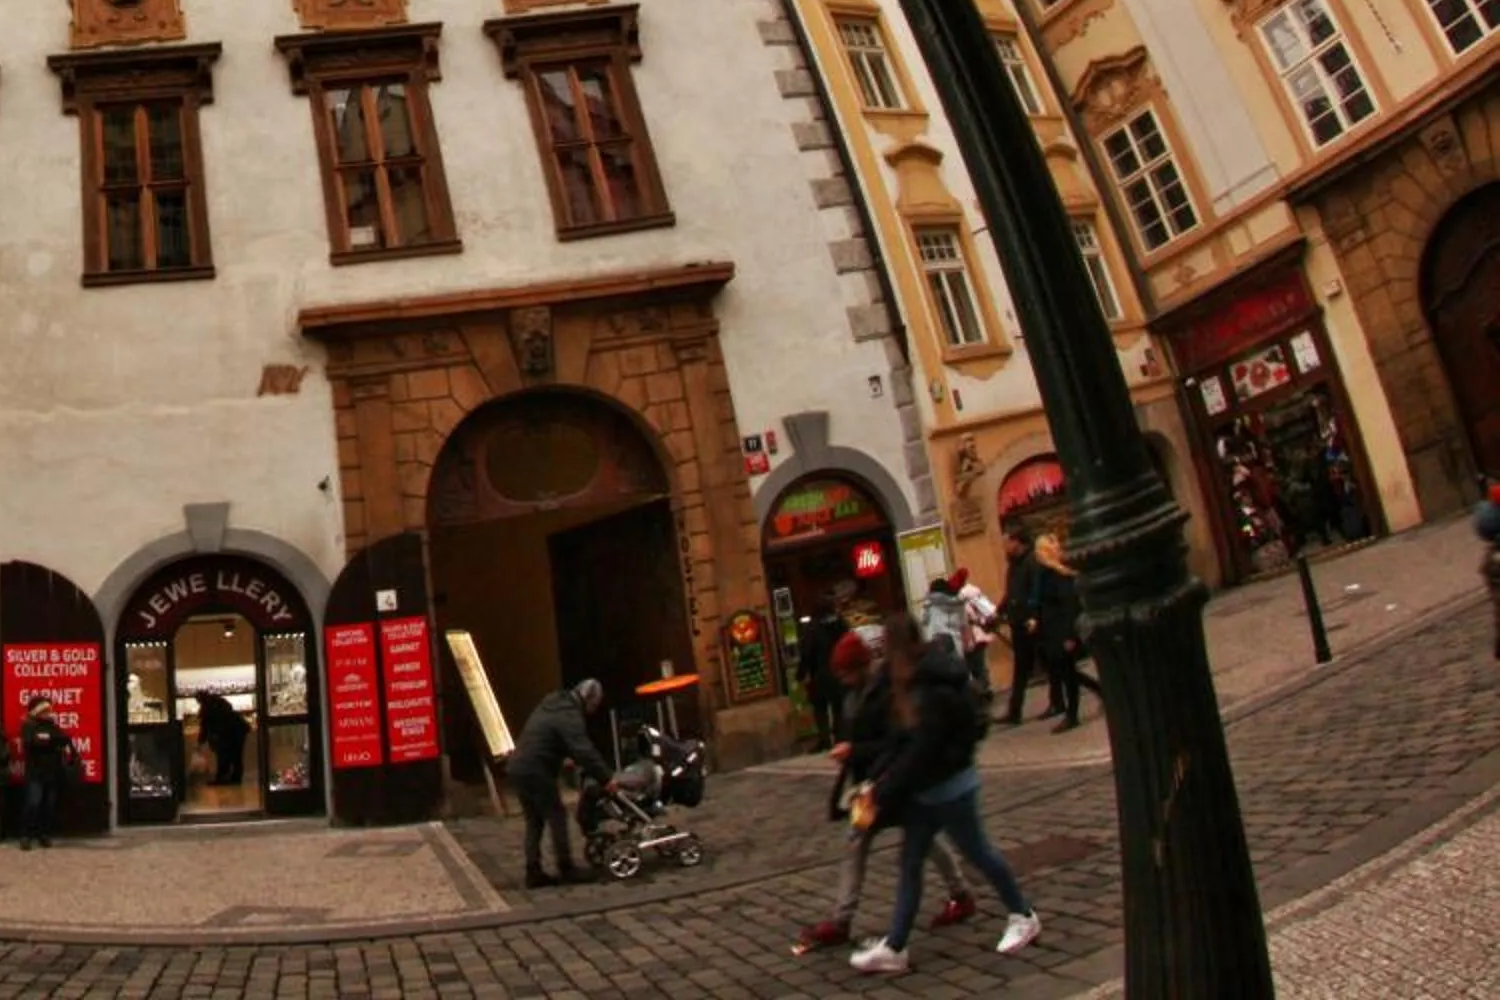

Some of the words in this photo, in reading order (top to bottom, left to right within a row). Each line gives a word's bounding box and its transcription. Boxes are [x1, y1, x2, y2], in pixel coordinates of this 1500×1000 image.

[857, 547, 881, 569] illy
[7, 648, 47, 663] SILVER
[62, 647, 97, 662] GOLD
[13, 662, 88, 678] COLLECTION
